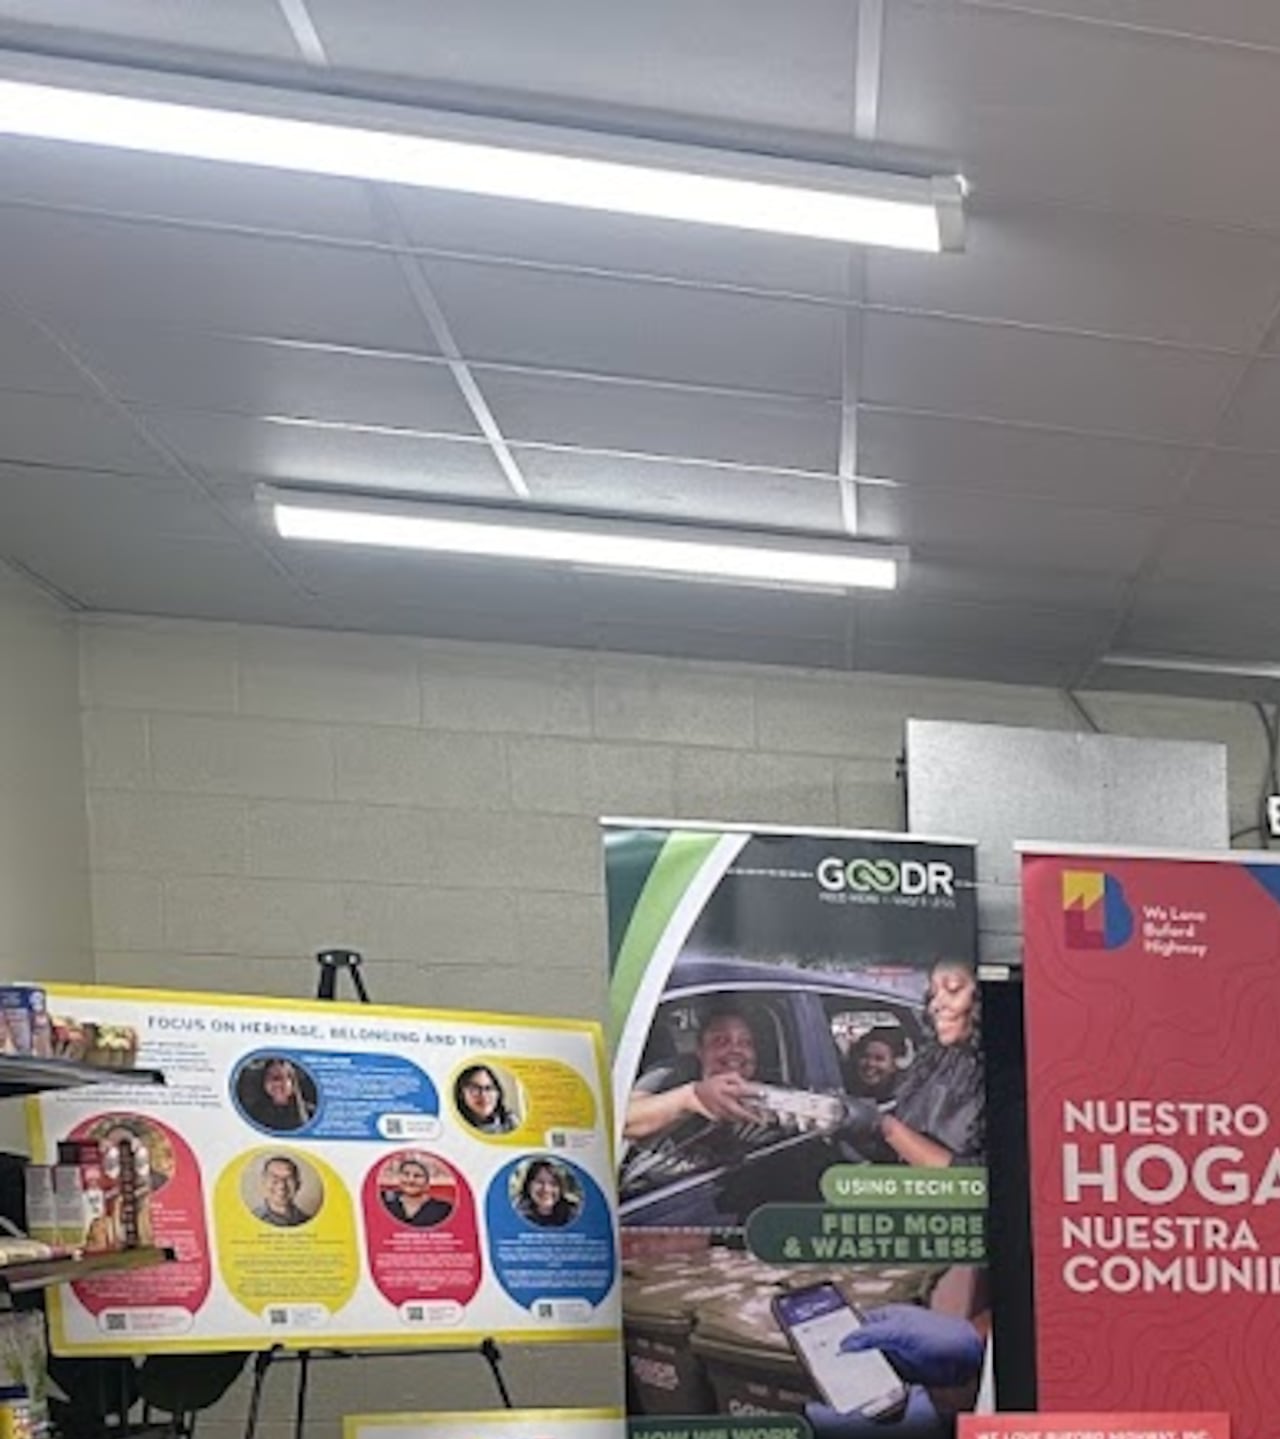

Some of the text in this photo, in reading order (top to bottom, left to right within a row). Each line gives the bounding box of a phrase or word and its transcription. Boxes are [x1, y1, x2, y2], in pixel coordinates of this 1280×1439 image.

[817, 857, 954, 896] GOODR
[1143, 906, 1207, 922] We Love
[1143, 922, 1195, 937] Buford
[1143, 939, 1208, 957] Highway
[148, 1015, 508, 1049] FOCUS ON HERITAGE, BELONGING AND TRUST
[1064, 1100, 1269, 1137] NUESTRO
[836, 1178, 986, 1197] USING TECH TO
[822, 1213, 984, 1235] FEED MORE
[1062, 1216, 1260, 1251] NUESTRA
[783, 1236, 986, 1259] & WASTE LESS
